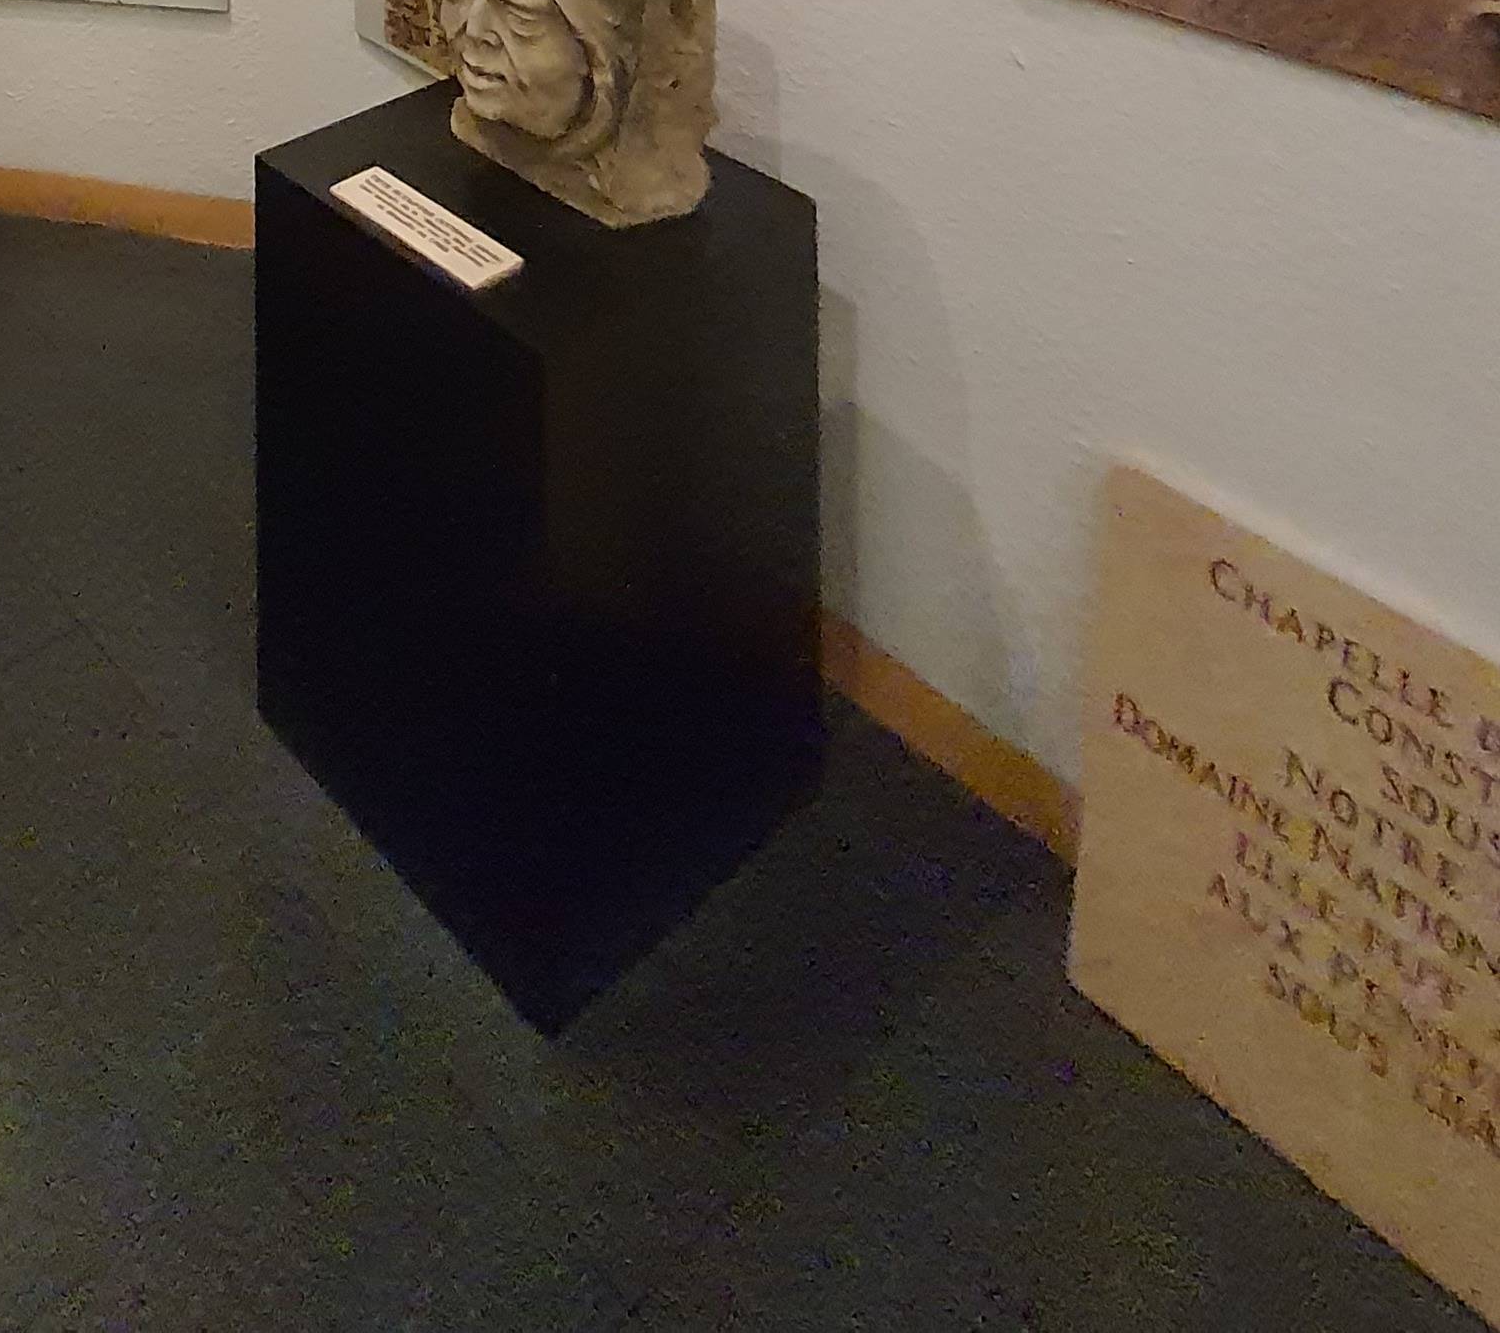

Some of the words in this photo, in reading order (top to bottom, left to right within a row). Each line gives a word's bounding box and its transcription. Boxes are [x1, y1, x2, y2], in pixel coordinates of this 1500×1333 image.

[1208, 556, 1453, 728] CHAPELLE
[1114, 690, 1291, 844] DOMAINE
[1279, 746, 1463, 902] NOTRE
[1206, 870, 1306, 963] AUX
[1264, 961, 1391, 1079] SOUS
